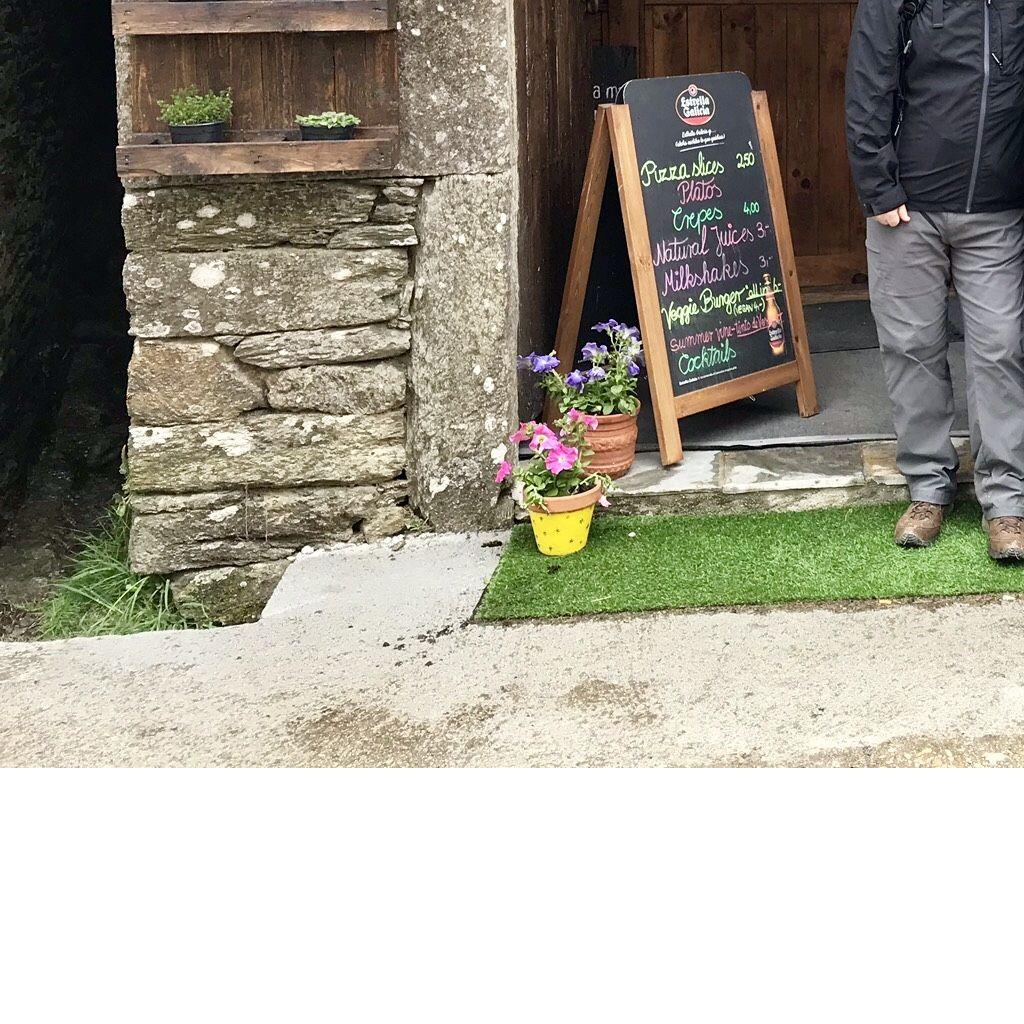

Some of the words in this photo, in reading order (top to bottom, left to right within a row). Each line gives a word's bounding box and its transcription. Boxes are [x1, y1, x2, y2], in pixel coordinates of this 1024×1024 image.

[681, 95, 710, 108] Estrella
[683, 105, 711, 118] Galicia
[640, 160, 691, 187] Pizza
[691, 150, 725, 177] slices
[676, 176, 723, 205] Platos
[671, 206, 723, 235] Crepes
[653, 224, 710, 267] Natural
[710, 222, 755, 257] Juices
[661, 252, 749, 297] Milkshakes
[661, 296, 700, 331] Veggie
[699, 287, 745, 315] Burger
[669, 330, 714, 353] Summer
[678, 338, 737, 376] Cocktails
